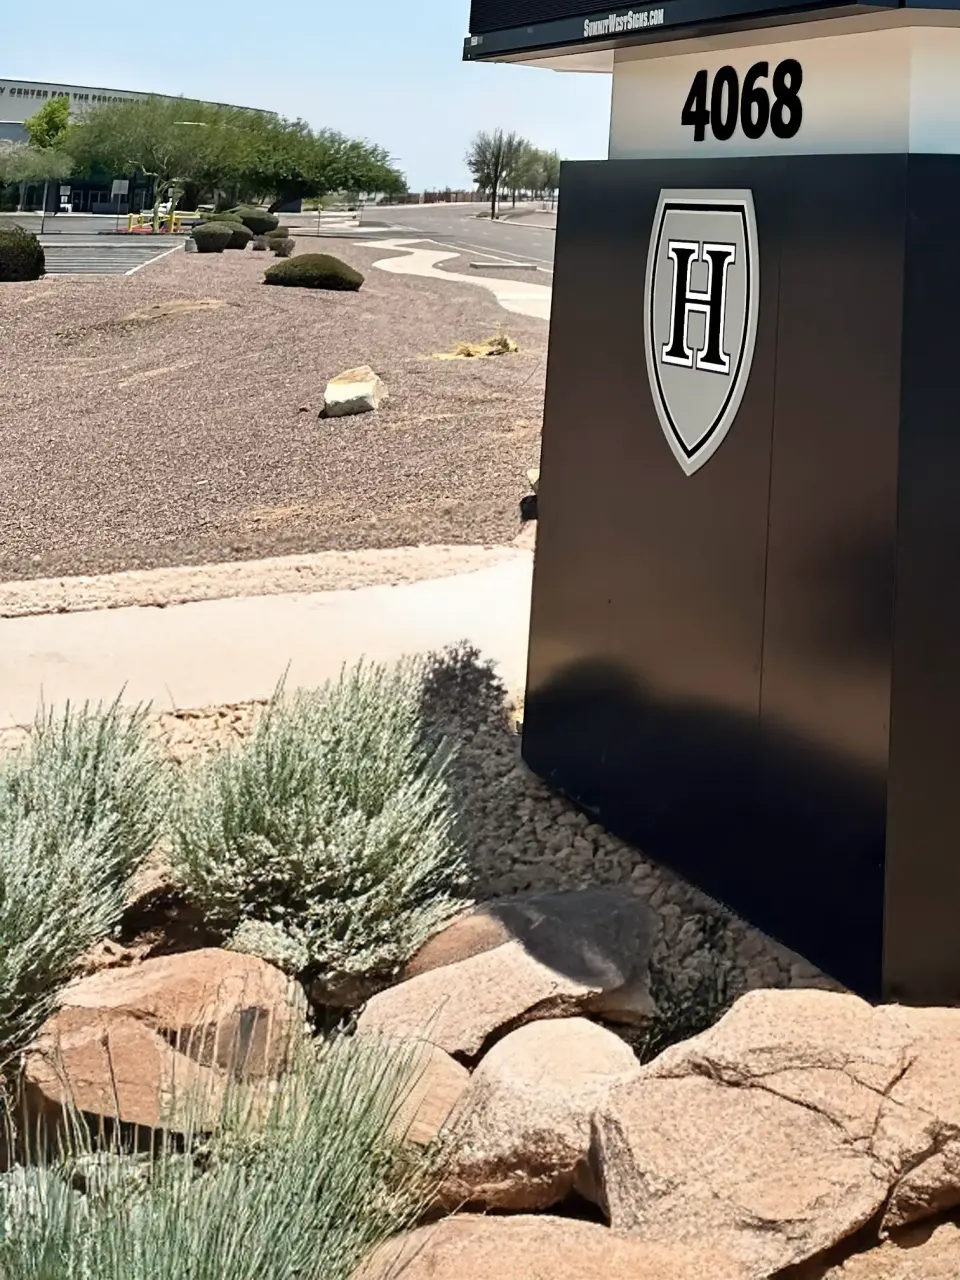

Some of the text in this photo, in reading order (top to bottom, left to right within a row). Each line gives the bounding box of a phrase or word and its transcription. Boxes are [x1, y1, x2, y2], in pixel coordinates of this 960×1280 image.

[9, 87, 48, 97] CENTER
[73, 92, 89, 100] THE
[680, 58, 803, 143] 4068
[661, 239, 736, 376] H
